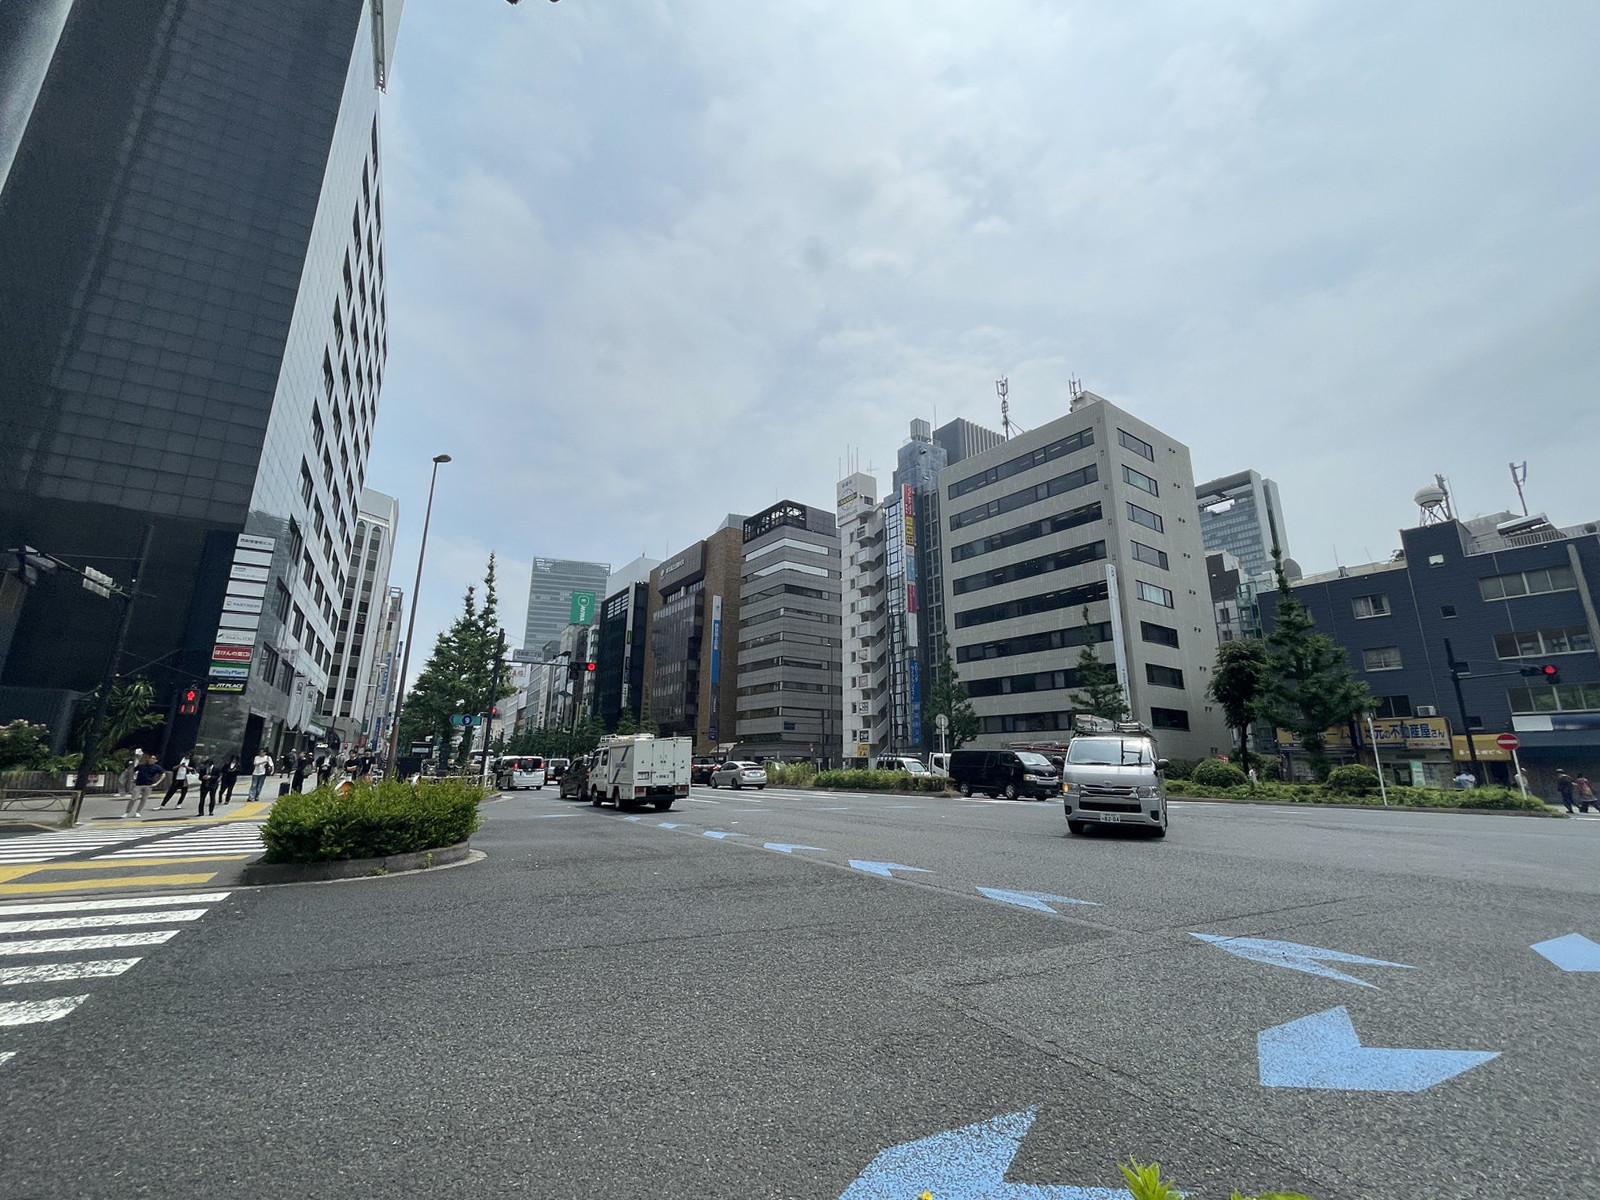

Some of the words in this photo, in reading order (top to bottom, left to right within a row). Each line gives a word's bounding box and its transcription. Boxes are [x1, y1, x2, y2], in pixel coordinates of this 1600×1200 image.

[215, 649, 250, 657] ほけんの窓口
[212, 668, 246, 676] FamilyMart
[1365, 723, 1445, 739] 地元の不動産屋さん
